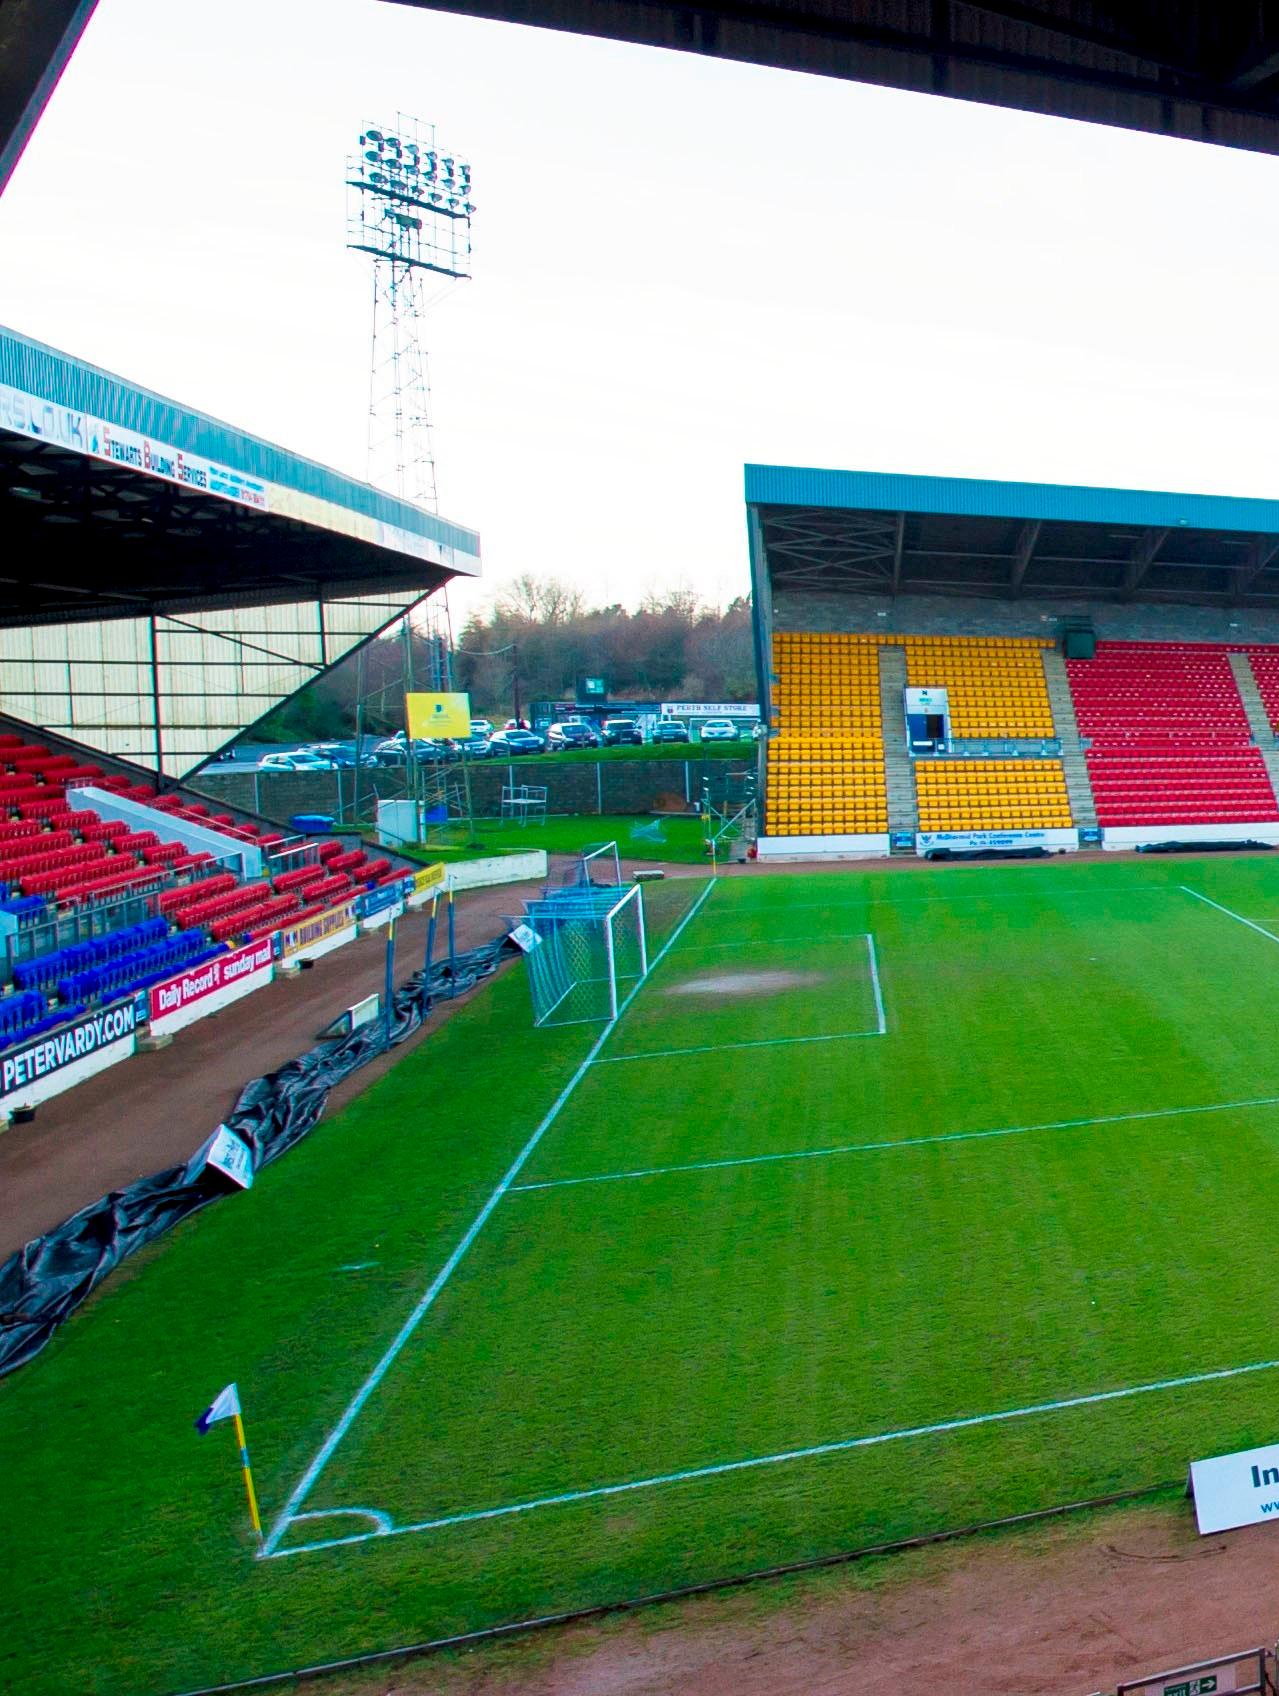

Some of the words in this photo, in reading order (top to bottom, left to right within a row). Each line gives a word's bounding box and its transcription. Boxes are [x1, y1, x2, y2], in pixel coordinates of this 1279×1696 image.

[158, 985, 182, 1011] Daily
[182, 967, 215, 1000] Record
[223, 954, 254, 981] sunday
[3, 1004, 135, 1091] PETERVARDY.COM
